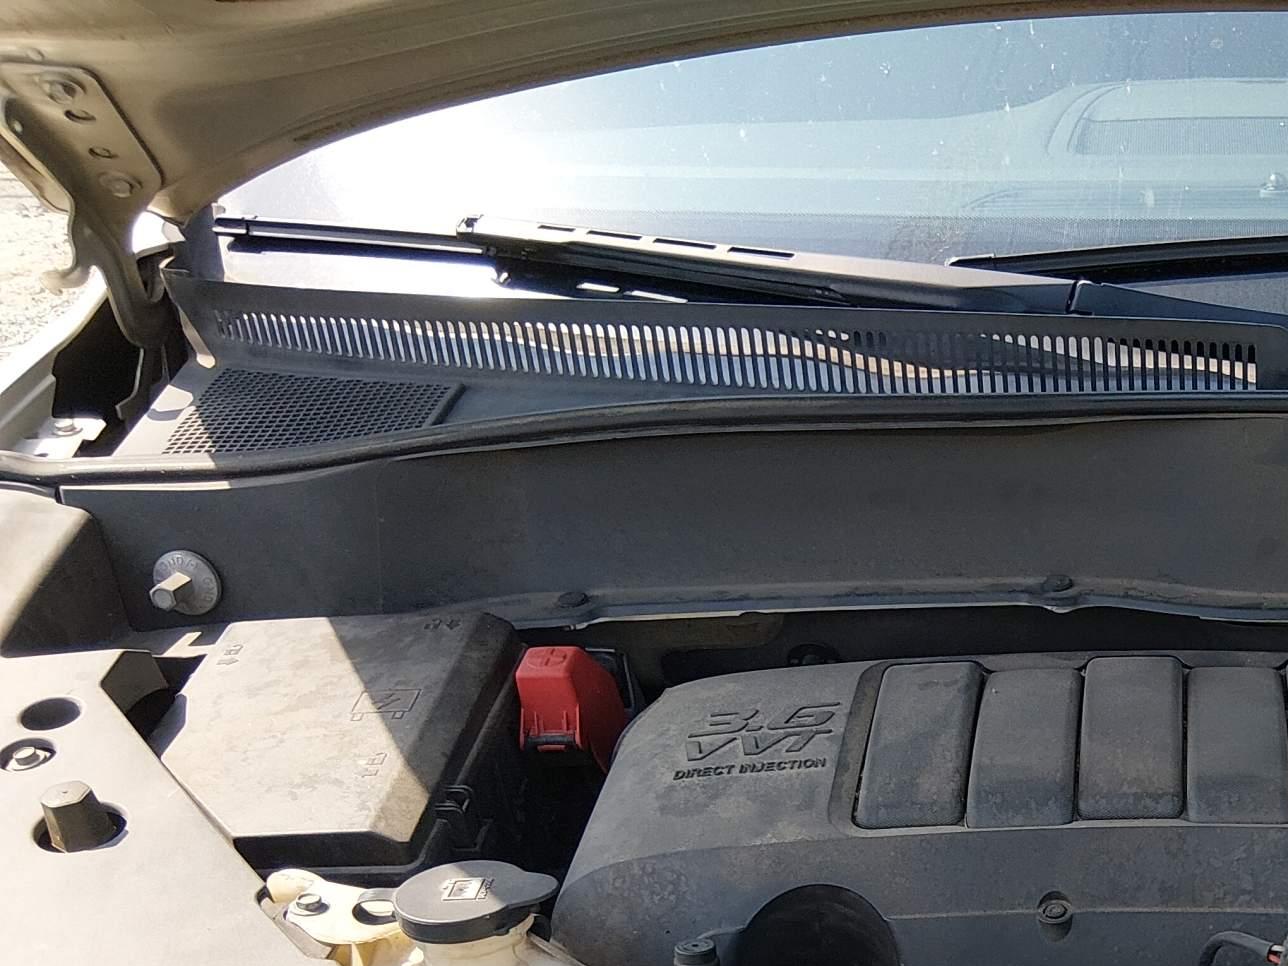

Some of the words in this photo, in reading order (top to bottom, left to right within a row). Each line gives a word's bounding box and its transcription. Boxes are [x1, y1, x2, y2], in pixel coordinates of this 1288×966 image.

[687, 701, 841, 739] 3.6
[685, 729, 833, 762] VVT
[672, 764, 736, 781] DIRECT
[738, 757, 827, 774] INJECTION
